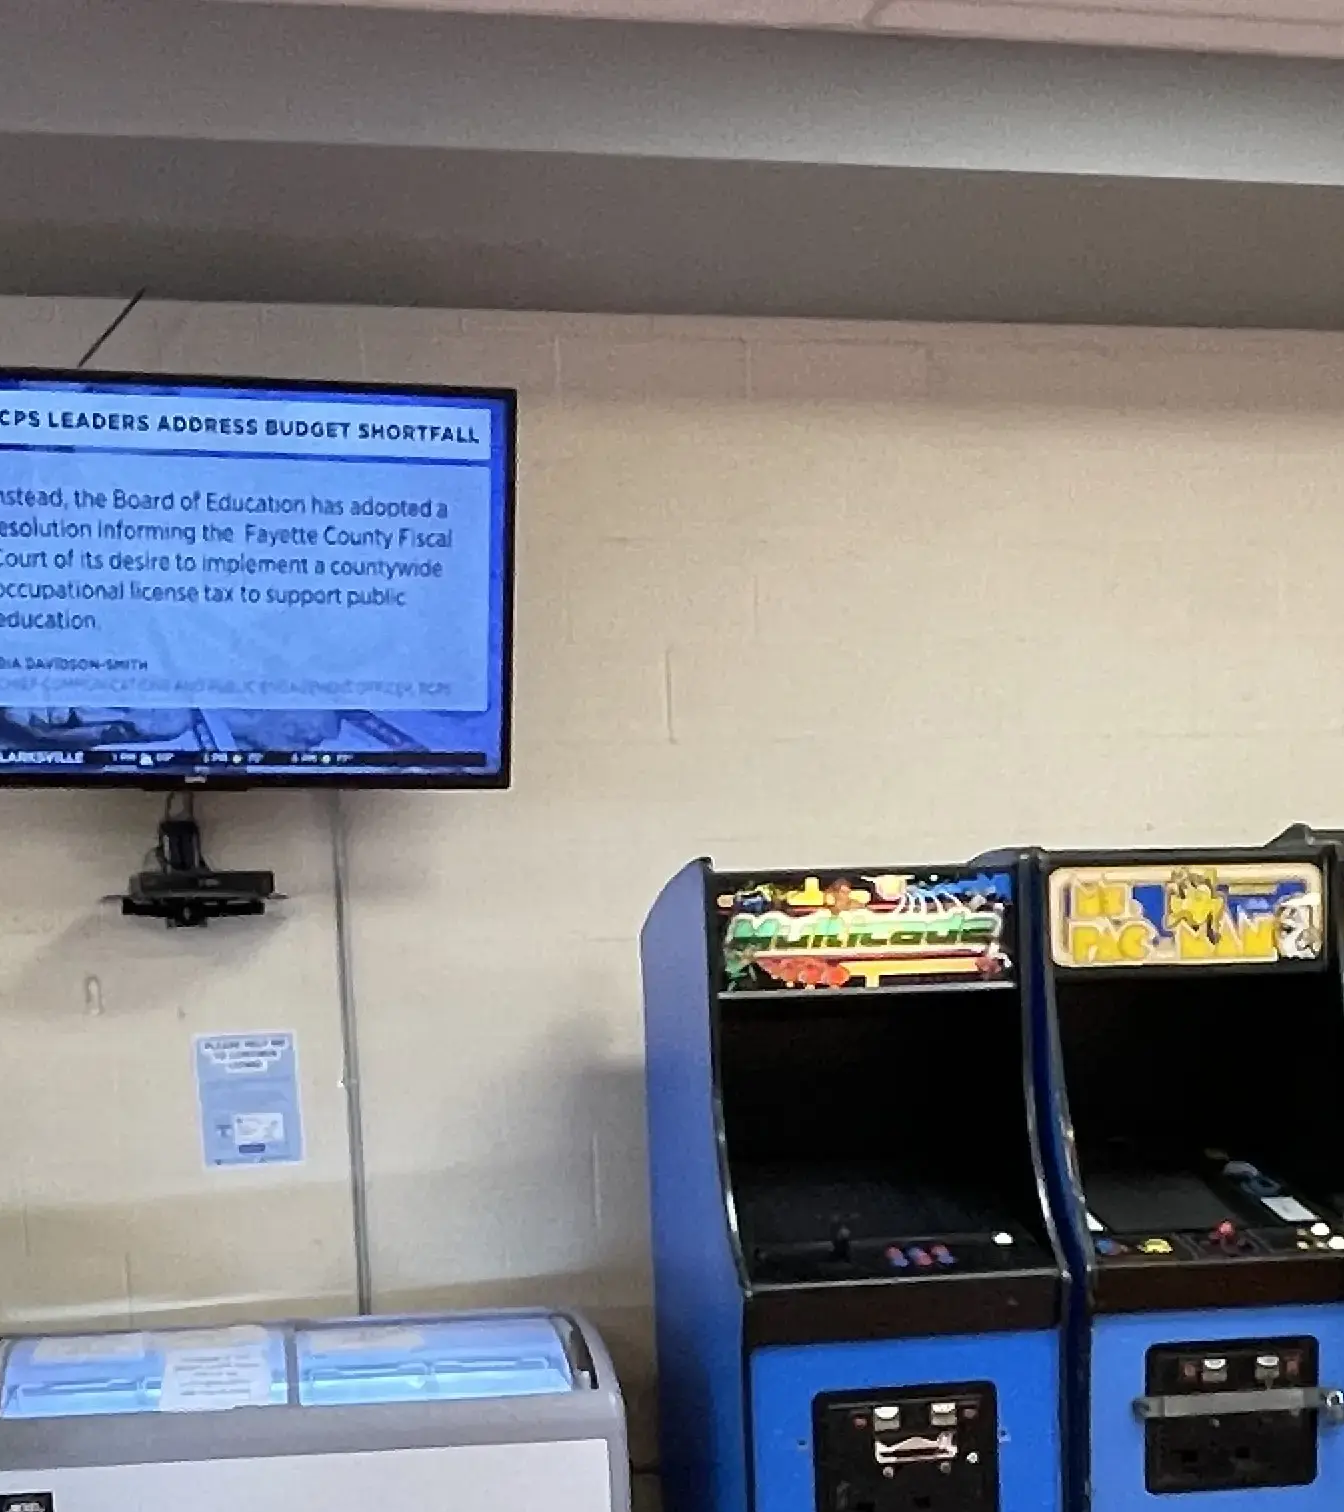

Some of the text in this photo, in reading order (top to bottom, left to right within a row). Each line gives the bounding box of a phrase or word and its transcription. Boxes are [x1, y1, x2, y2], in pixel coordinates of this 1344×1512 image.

[48, 411, 150, 432] LEADERS
[157, 415, 258, 435] ADDRESS
[266, 418, 351, 439] BUDGET
[358, 422, 480, 444] SHORTFALL
[74, 488, 107, 509] the
[113, 488, 174, 510] Board
[181, 490, 201, 510] of
[207, 492, 305, 515] Education
[312, 495, 343, 516] has
[350, 496, 432, 521] adopted
[436, 502, 448, 519] a
[98, 520, 196, 545] informing
[203, 522, 233, 544] the
[245, 524, 318, 548] Fayette
[323, 525, 393, 550] County
[399, 527, 452, 549] Fiscal
[53, 548, 74, 569] of
[81, 550, 104, 570] its
[109, 550, 169, 572] desire
[175, 553, 195, 572] to
[203, 553, 307, 576] implement
[315, 560, 325, 575] a
[331, 558, 443, 580] countywide
[130, 580, 199, 602] license
[205, 585, 234, 602] tax
[240, 587, 261, 604] to
[266, 587, 341, 608] support
[347, 586, 407, 608] public
